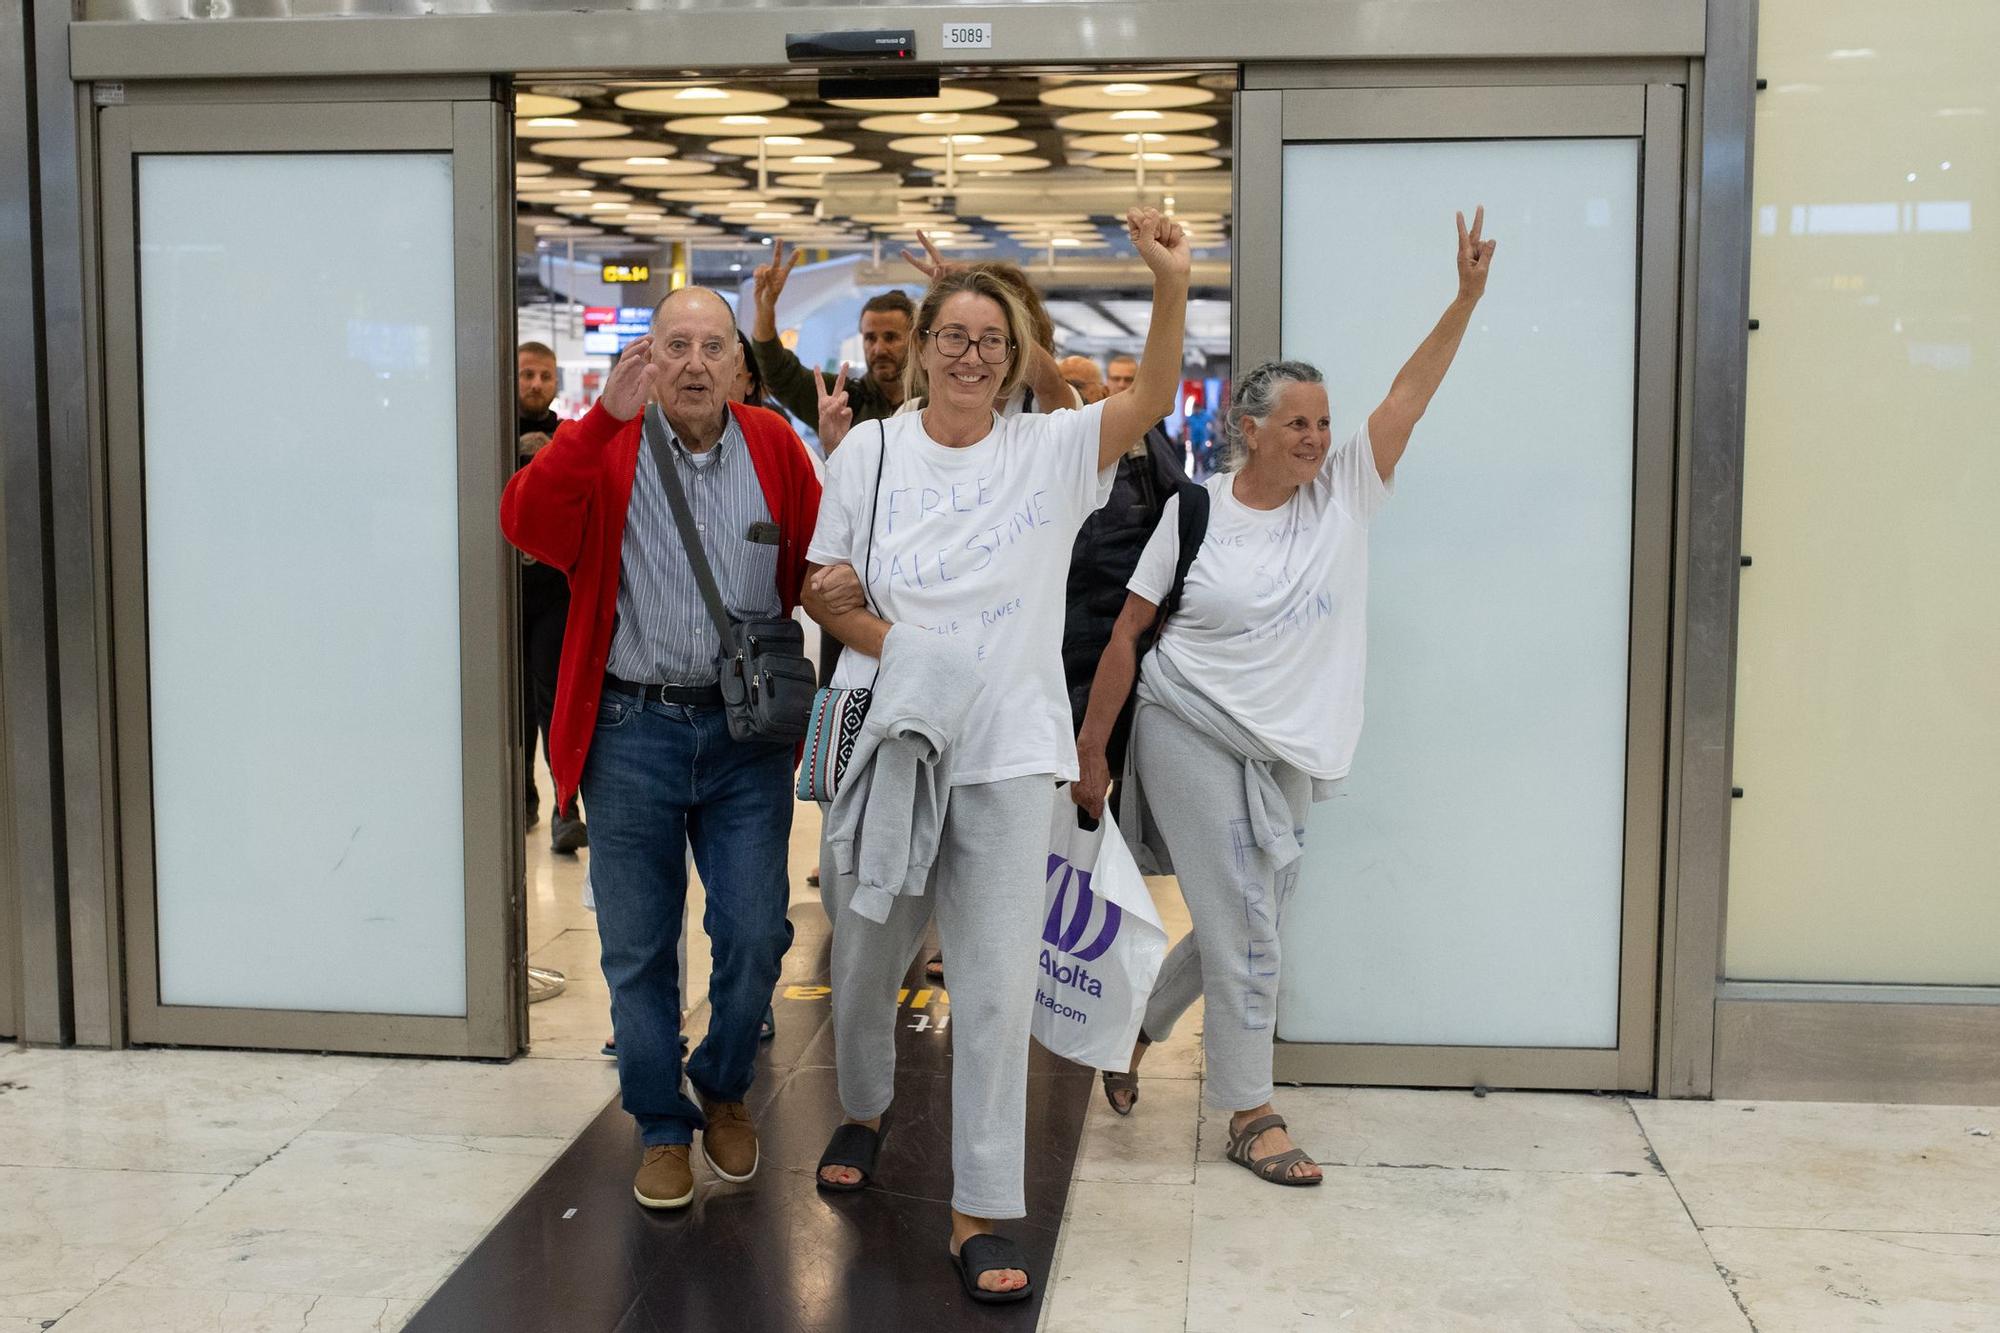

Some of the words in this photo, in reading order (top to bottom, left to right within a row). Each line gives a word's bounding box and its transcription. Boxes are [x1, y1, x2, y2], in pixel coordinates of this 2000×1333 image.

[951, 28, 983, 44] 5089
[888, 476, 994, 534] FREE
[981, 597, 1022, 629] RIVER
